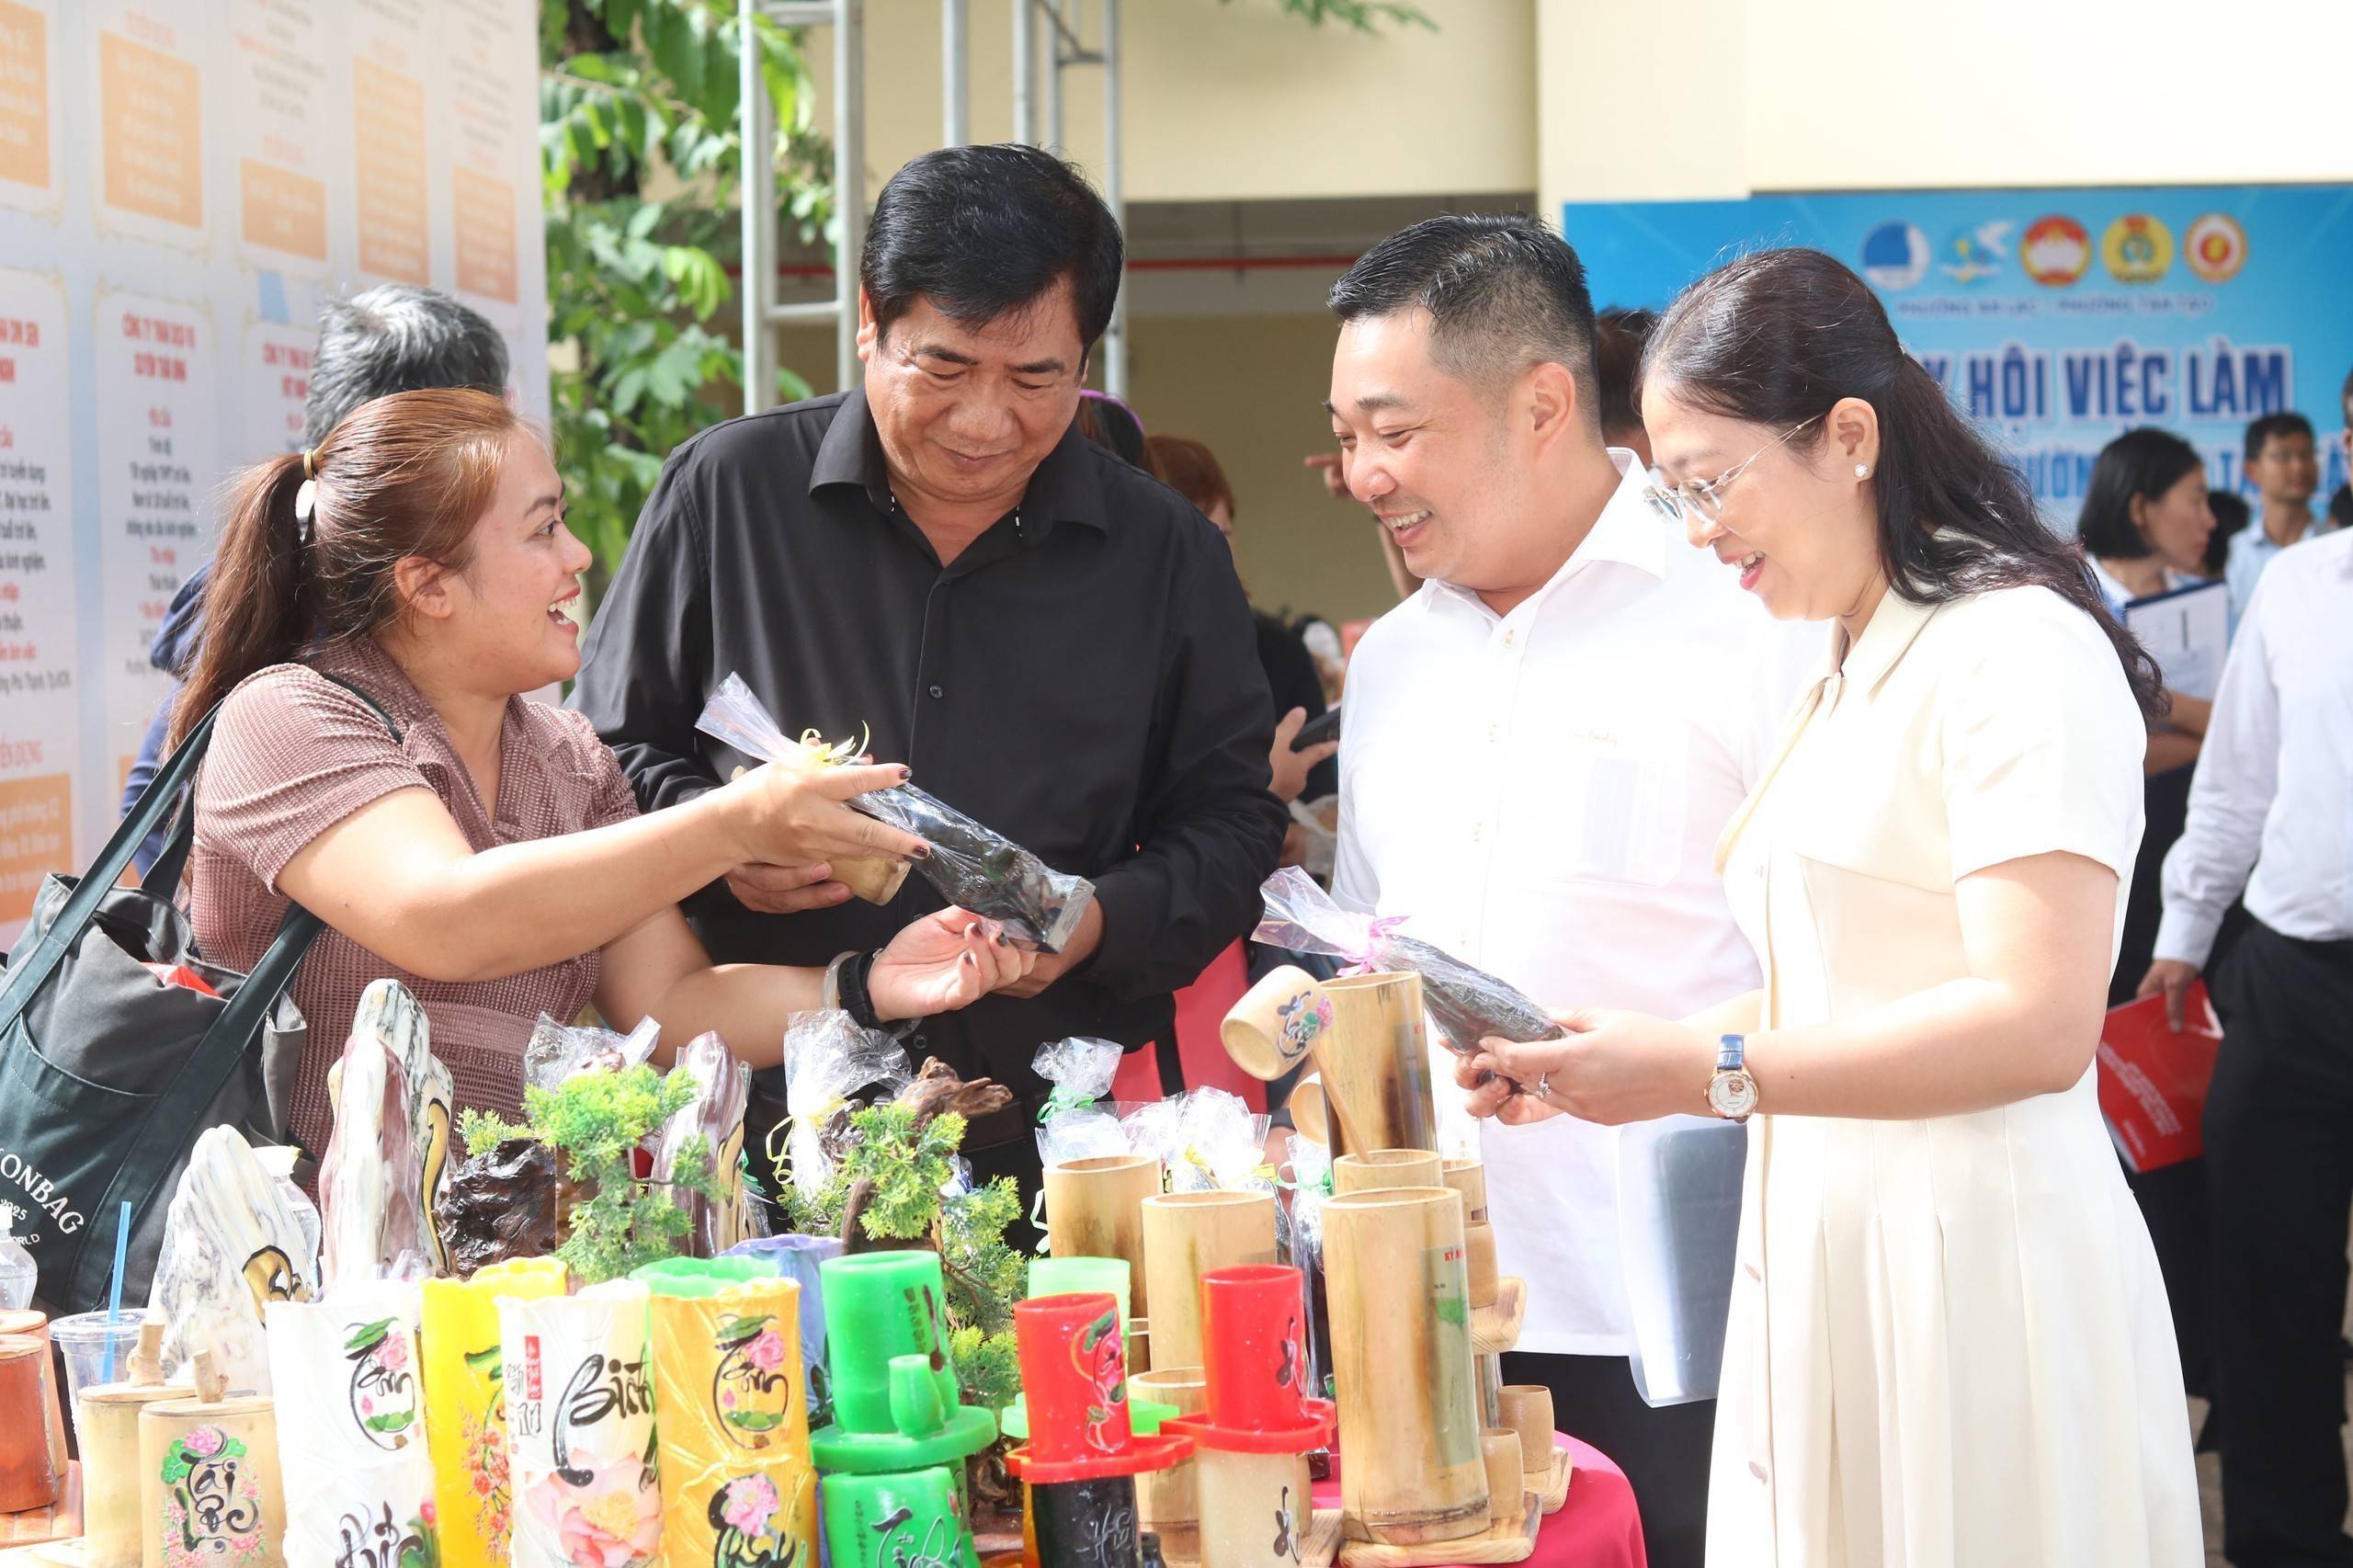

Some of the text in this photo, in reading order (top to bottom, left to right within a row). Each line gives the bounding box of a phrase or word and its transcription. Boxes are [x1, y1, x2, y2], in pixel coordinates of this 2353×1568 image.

[1969, 335, 2285, 436] HỘI VIỆC LÀM
[0, 1147, 85, 1234] ONBAG
[10, 1233, 40, 1245] ORLD
